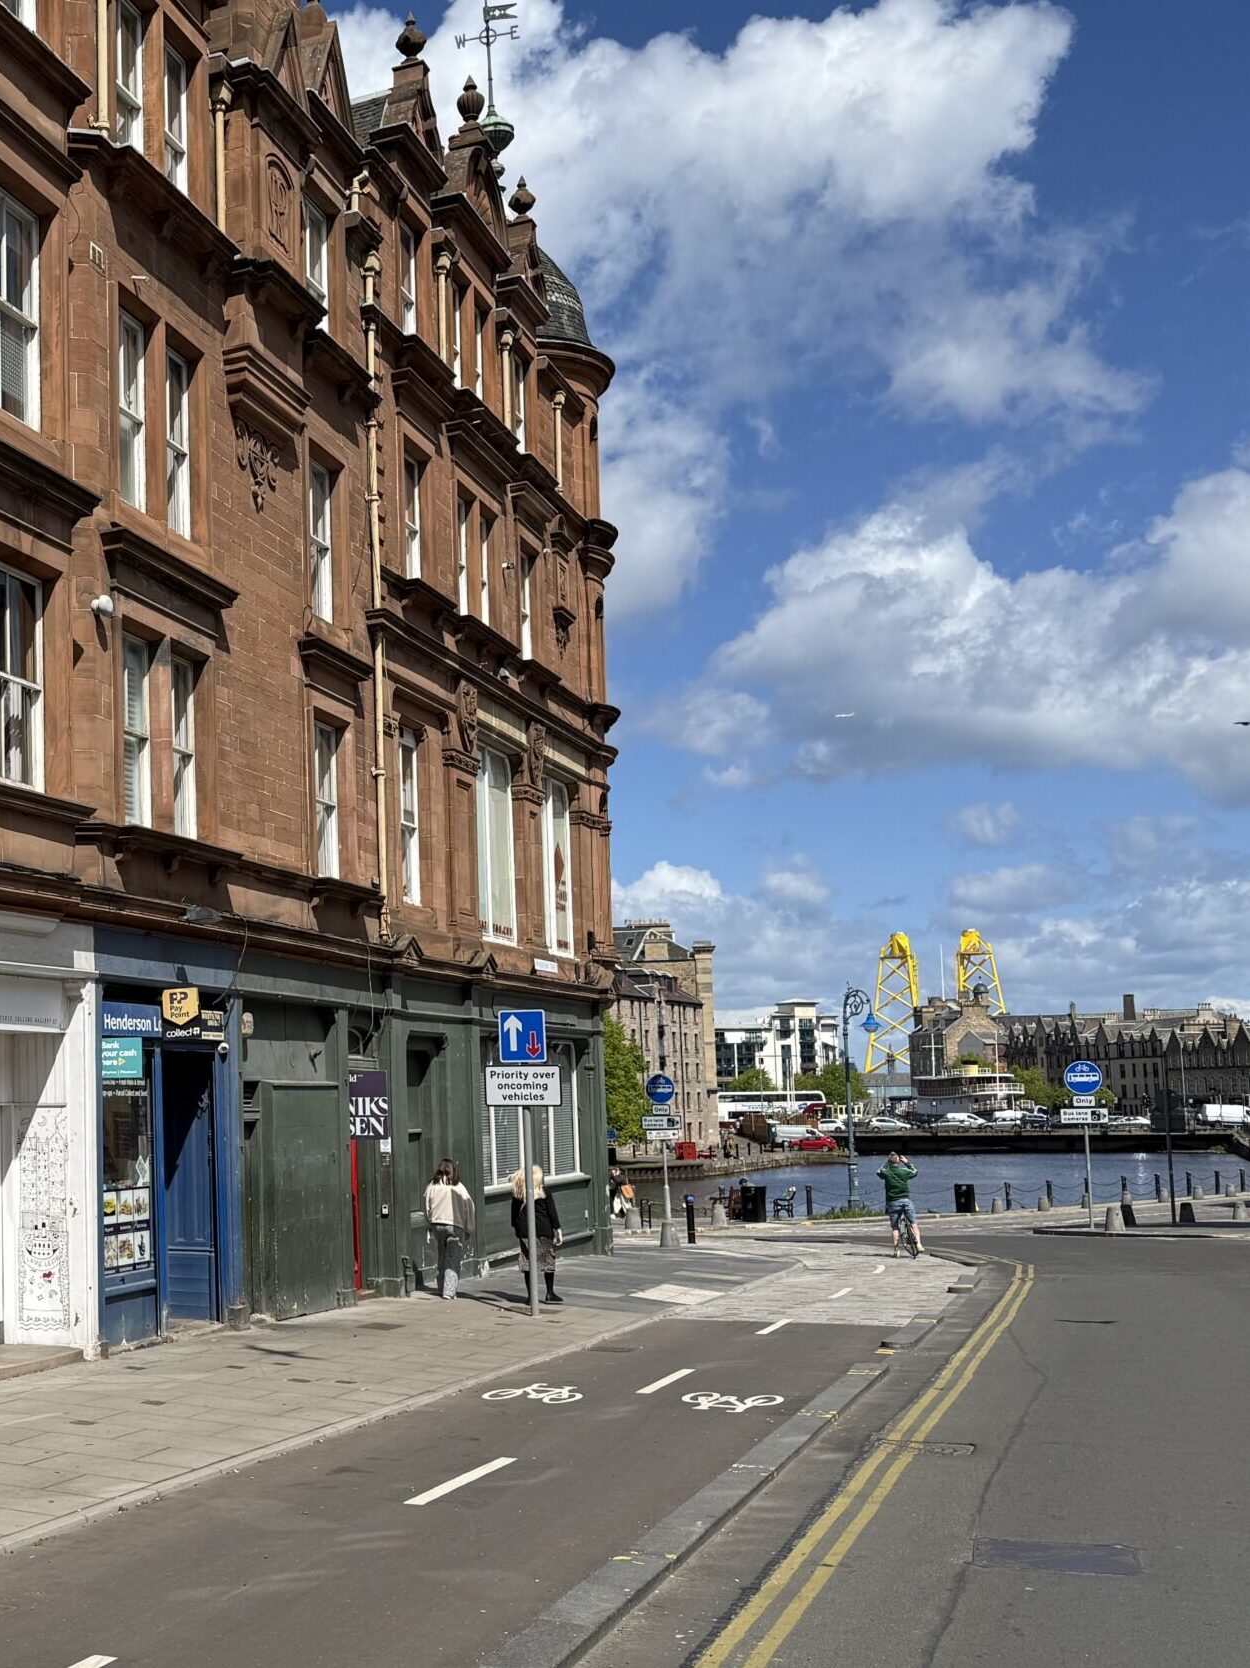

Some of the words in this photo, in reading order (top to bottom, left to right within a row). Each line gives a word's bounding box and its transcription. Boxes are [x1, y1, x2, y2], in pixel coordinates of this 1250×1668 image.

[511, 25, 520, 40] E
[455, 33, 466, 49] W
[170, 1005, 183, 1014] Pay
[170, 1011, 190, 1019] Point
[103, 1013, 152, 1031] Henderson
[490, 1070, 529, 1080] Priority
[497, 1082, 549, 1091] oncoming
[502, 1092, 545, 1101] vehicles
